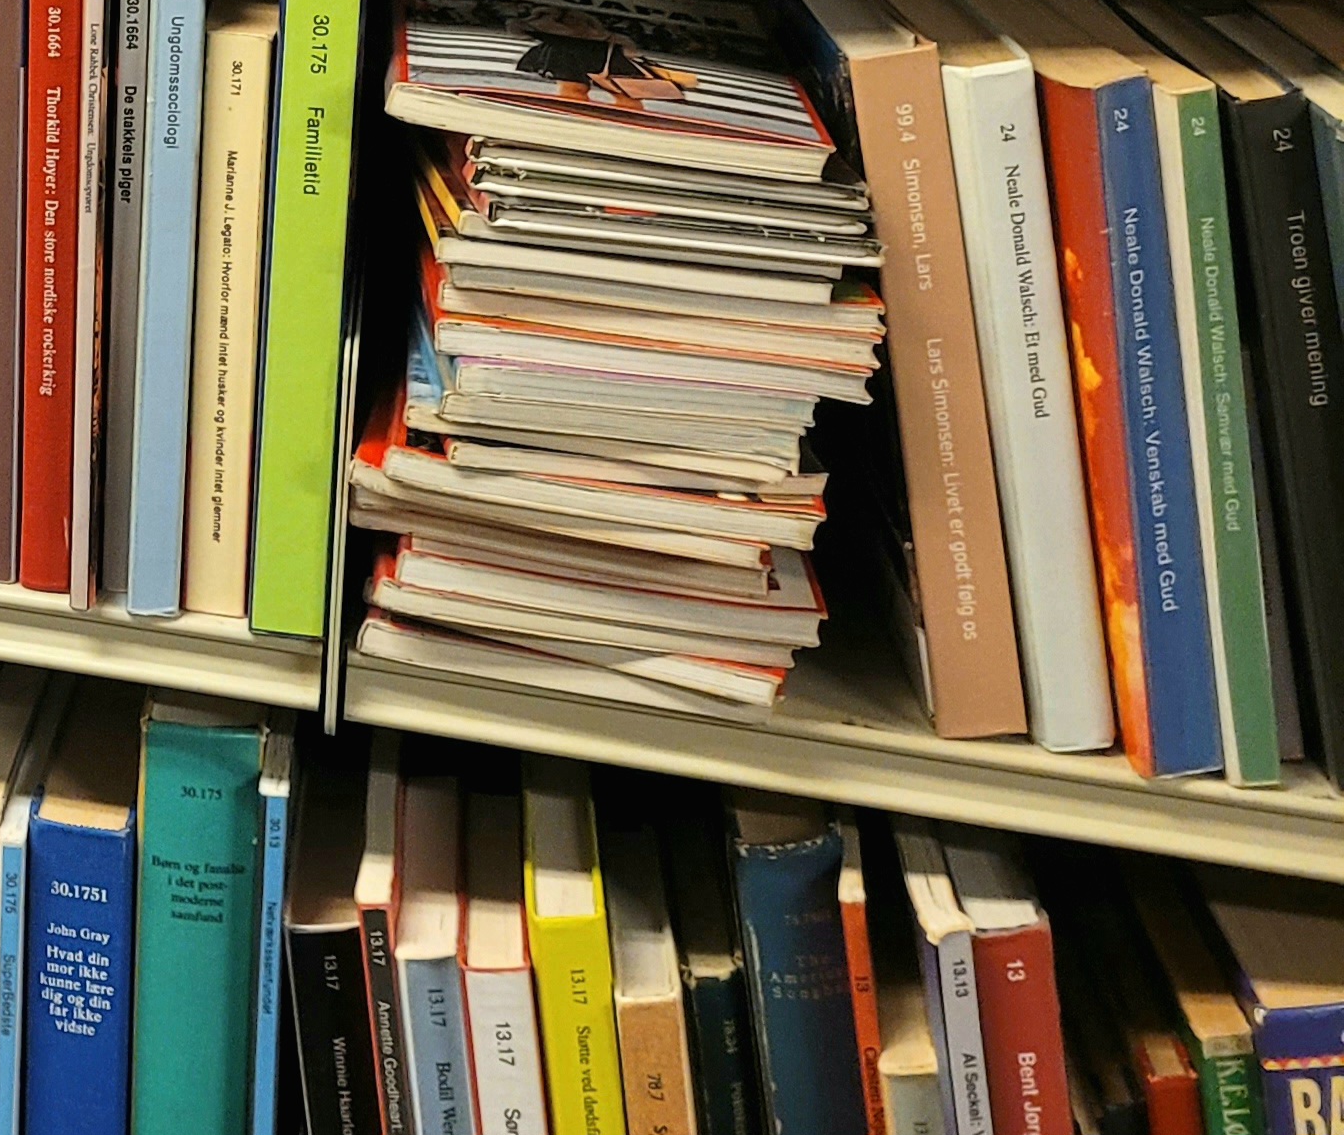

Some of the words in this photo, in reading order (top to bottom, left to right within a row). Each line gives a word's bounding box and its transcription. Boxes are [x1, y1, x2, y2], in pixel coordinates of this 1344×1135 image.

[309, 14, 330, 74] 30.175
[999, 123, 1017, 143] 24
[302, 106, 325, 196] Familietid
[1004, 163, 1024, 208] Neale
[1009, 211, 1032, 266] Donald
[1017, 268, 1038, 327] Walsch:
[1024, 330, 1041, 349] Et
[1026, 351, 1046, 384] med
[1031, 386, 1051, 419] Gud
[50, 880, 108, 903] 30.1751
[46, 922, 77, 939] John
[80, 927, 111, 945] Gray
[46, 944, 83, 963] Hvad
[88, 952, 110, 967] din
[369, 930, 386, 966] 13.17
[39, 972, 82, 991] kunne
[86, 981, 115, 996] lære
[46, 961, 75, 976] mor
[79, 965, 108, 981] ikke
[952, 958, 970, 998] 13.13
[41, 987, 63, 1005] dig
[67, 994, 85, 1008] og
[89, 996, 112, 1011] din
[49, 1002, 69, 1018] far
[73, 1007, 103, 1023] ikke
[55, 1019, 96, 1036] vidste
[494, 1021, 516, 1067] 13.17
